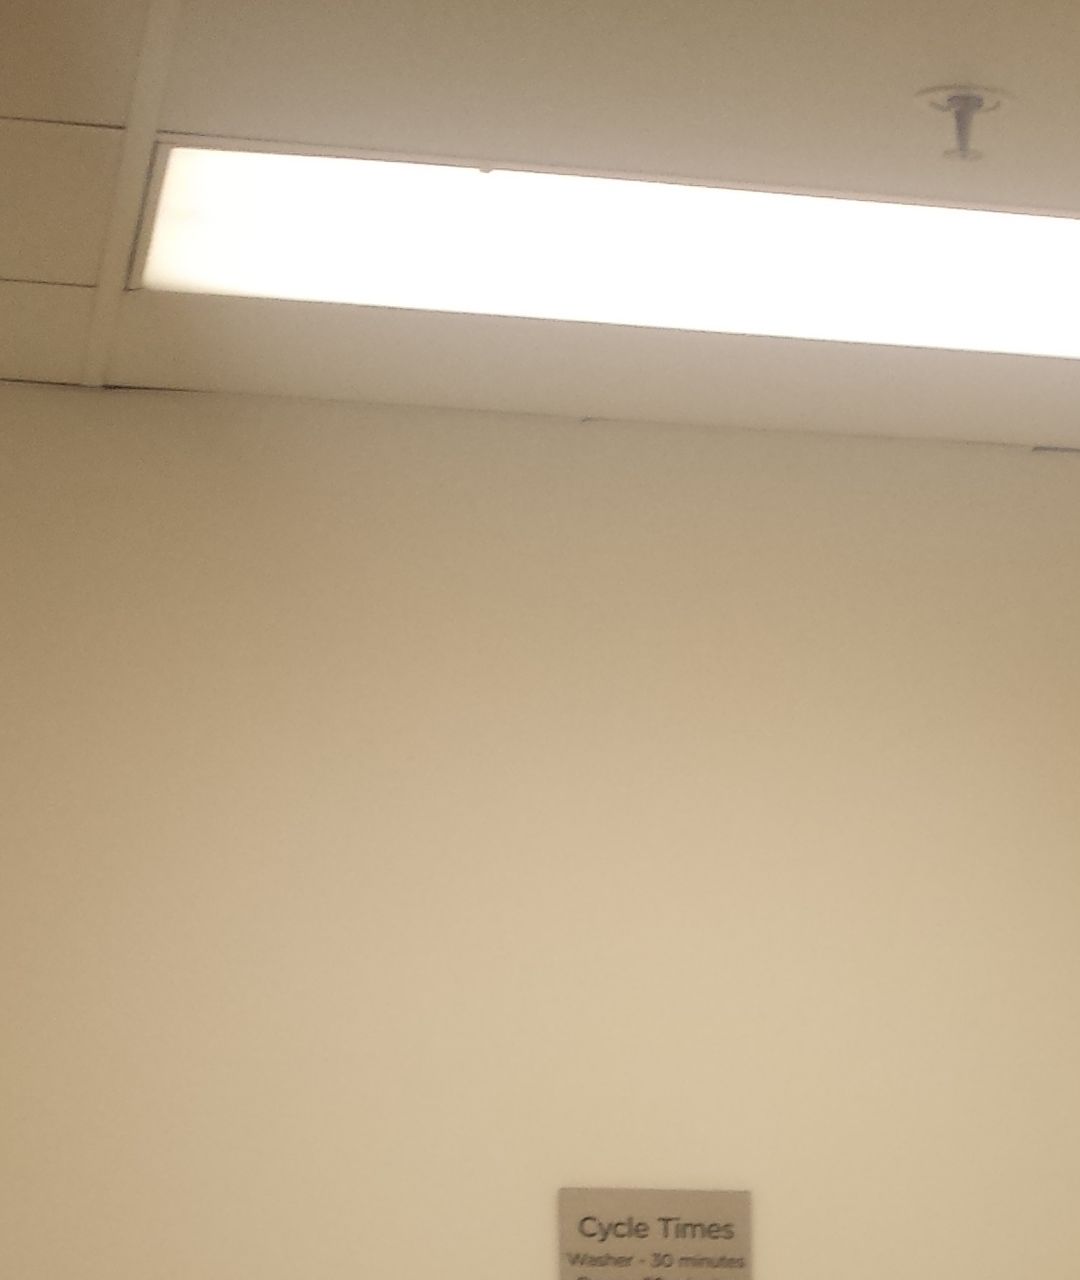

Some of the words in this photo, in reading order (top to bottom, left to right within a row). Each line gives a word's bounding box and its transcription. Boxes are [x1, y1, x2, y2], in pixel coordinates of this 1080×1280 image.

[577, 1215, 650, 1243] Cycle
[658, 1217, 735, 1240] Times
[567, 1253, 634, 1268] Washer
[651, 1253, 673, 1268] 30
[678, 1254, 745, 1270] minutes
